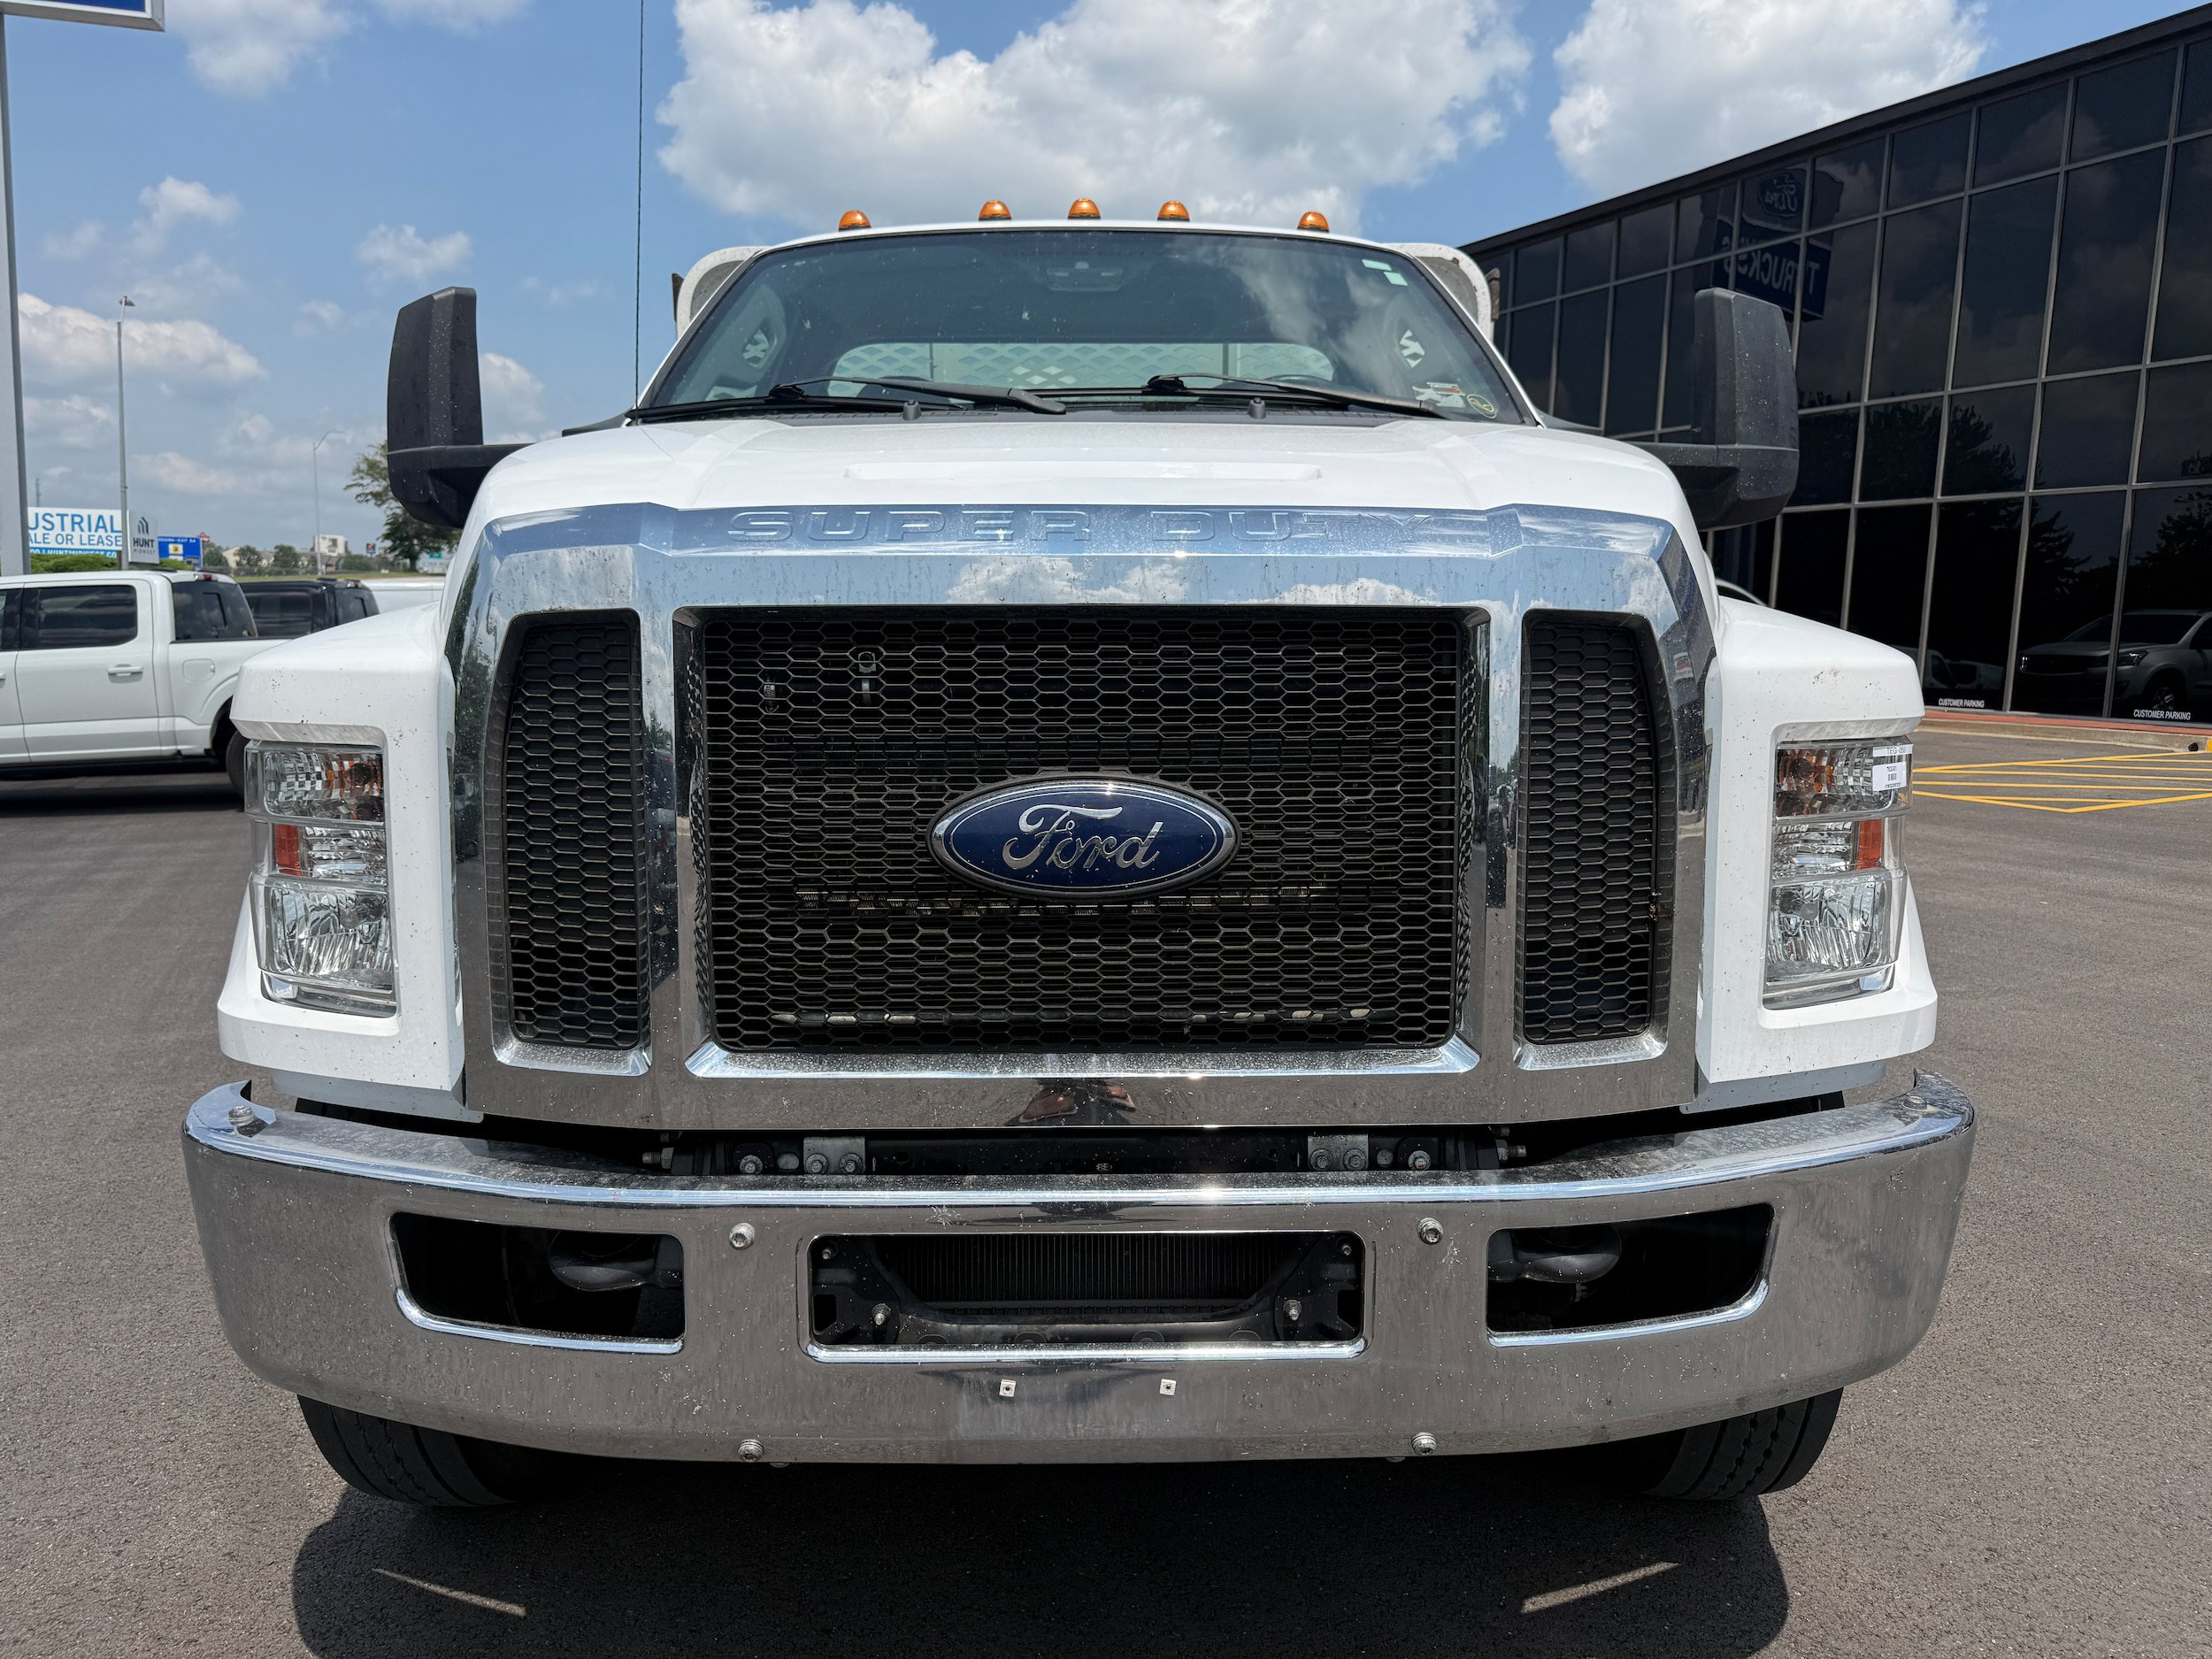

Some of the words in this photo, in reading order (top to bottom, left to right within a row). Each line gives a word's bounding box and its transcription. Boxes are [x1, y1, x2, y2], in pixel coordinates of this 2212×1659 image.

[726, 510, 1092, 542] SUPER
[1149, 511, 1432, 542] DUTY
[55, 533, 73, 545] OR
[80, 534, 122, 547] LEASE
[133, 537, 155, 548] HUNT
[1938, 697, 1963, 707] CUSTOMER
[1963, 699, 1985, 709] PARKING
[2133, 709, 2165, 719] CUSTOMER
[2165, 710, 2192, 720] PARKING
[1002, 803, 1164, 870] Ford
